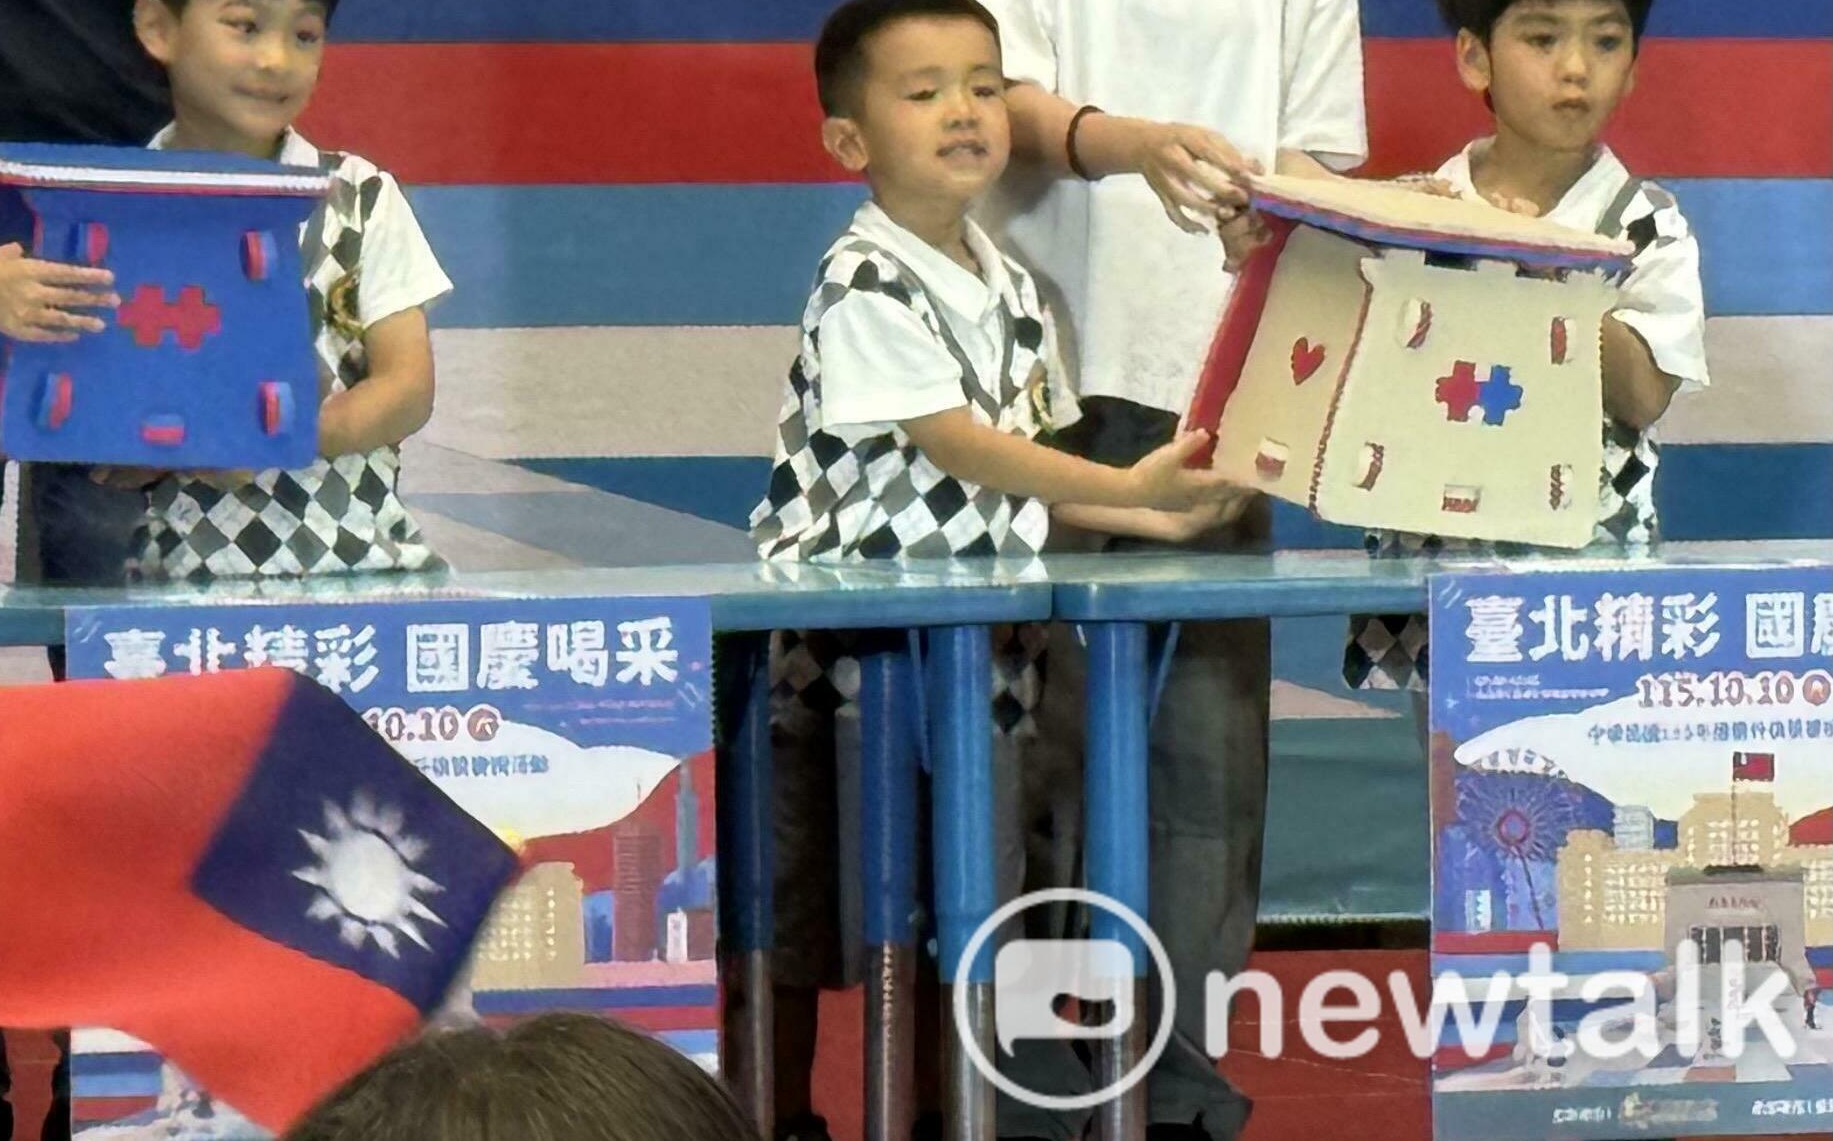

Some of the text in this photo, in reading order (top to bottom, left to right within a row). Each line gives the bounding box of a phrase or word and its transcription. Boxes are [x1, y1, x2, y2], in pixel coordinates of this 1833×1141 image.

[406, 616, 679, 693] 國慶喝采
[1465, 592, 1720, 661] 臺北精彩
